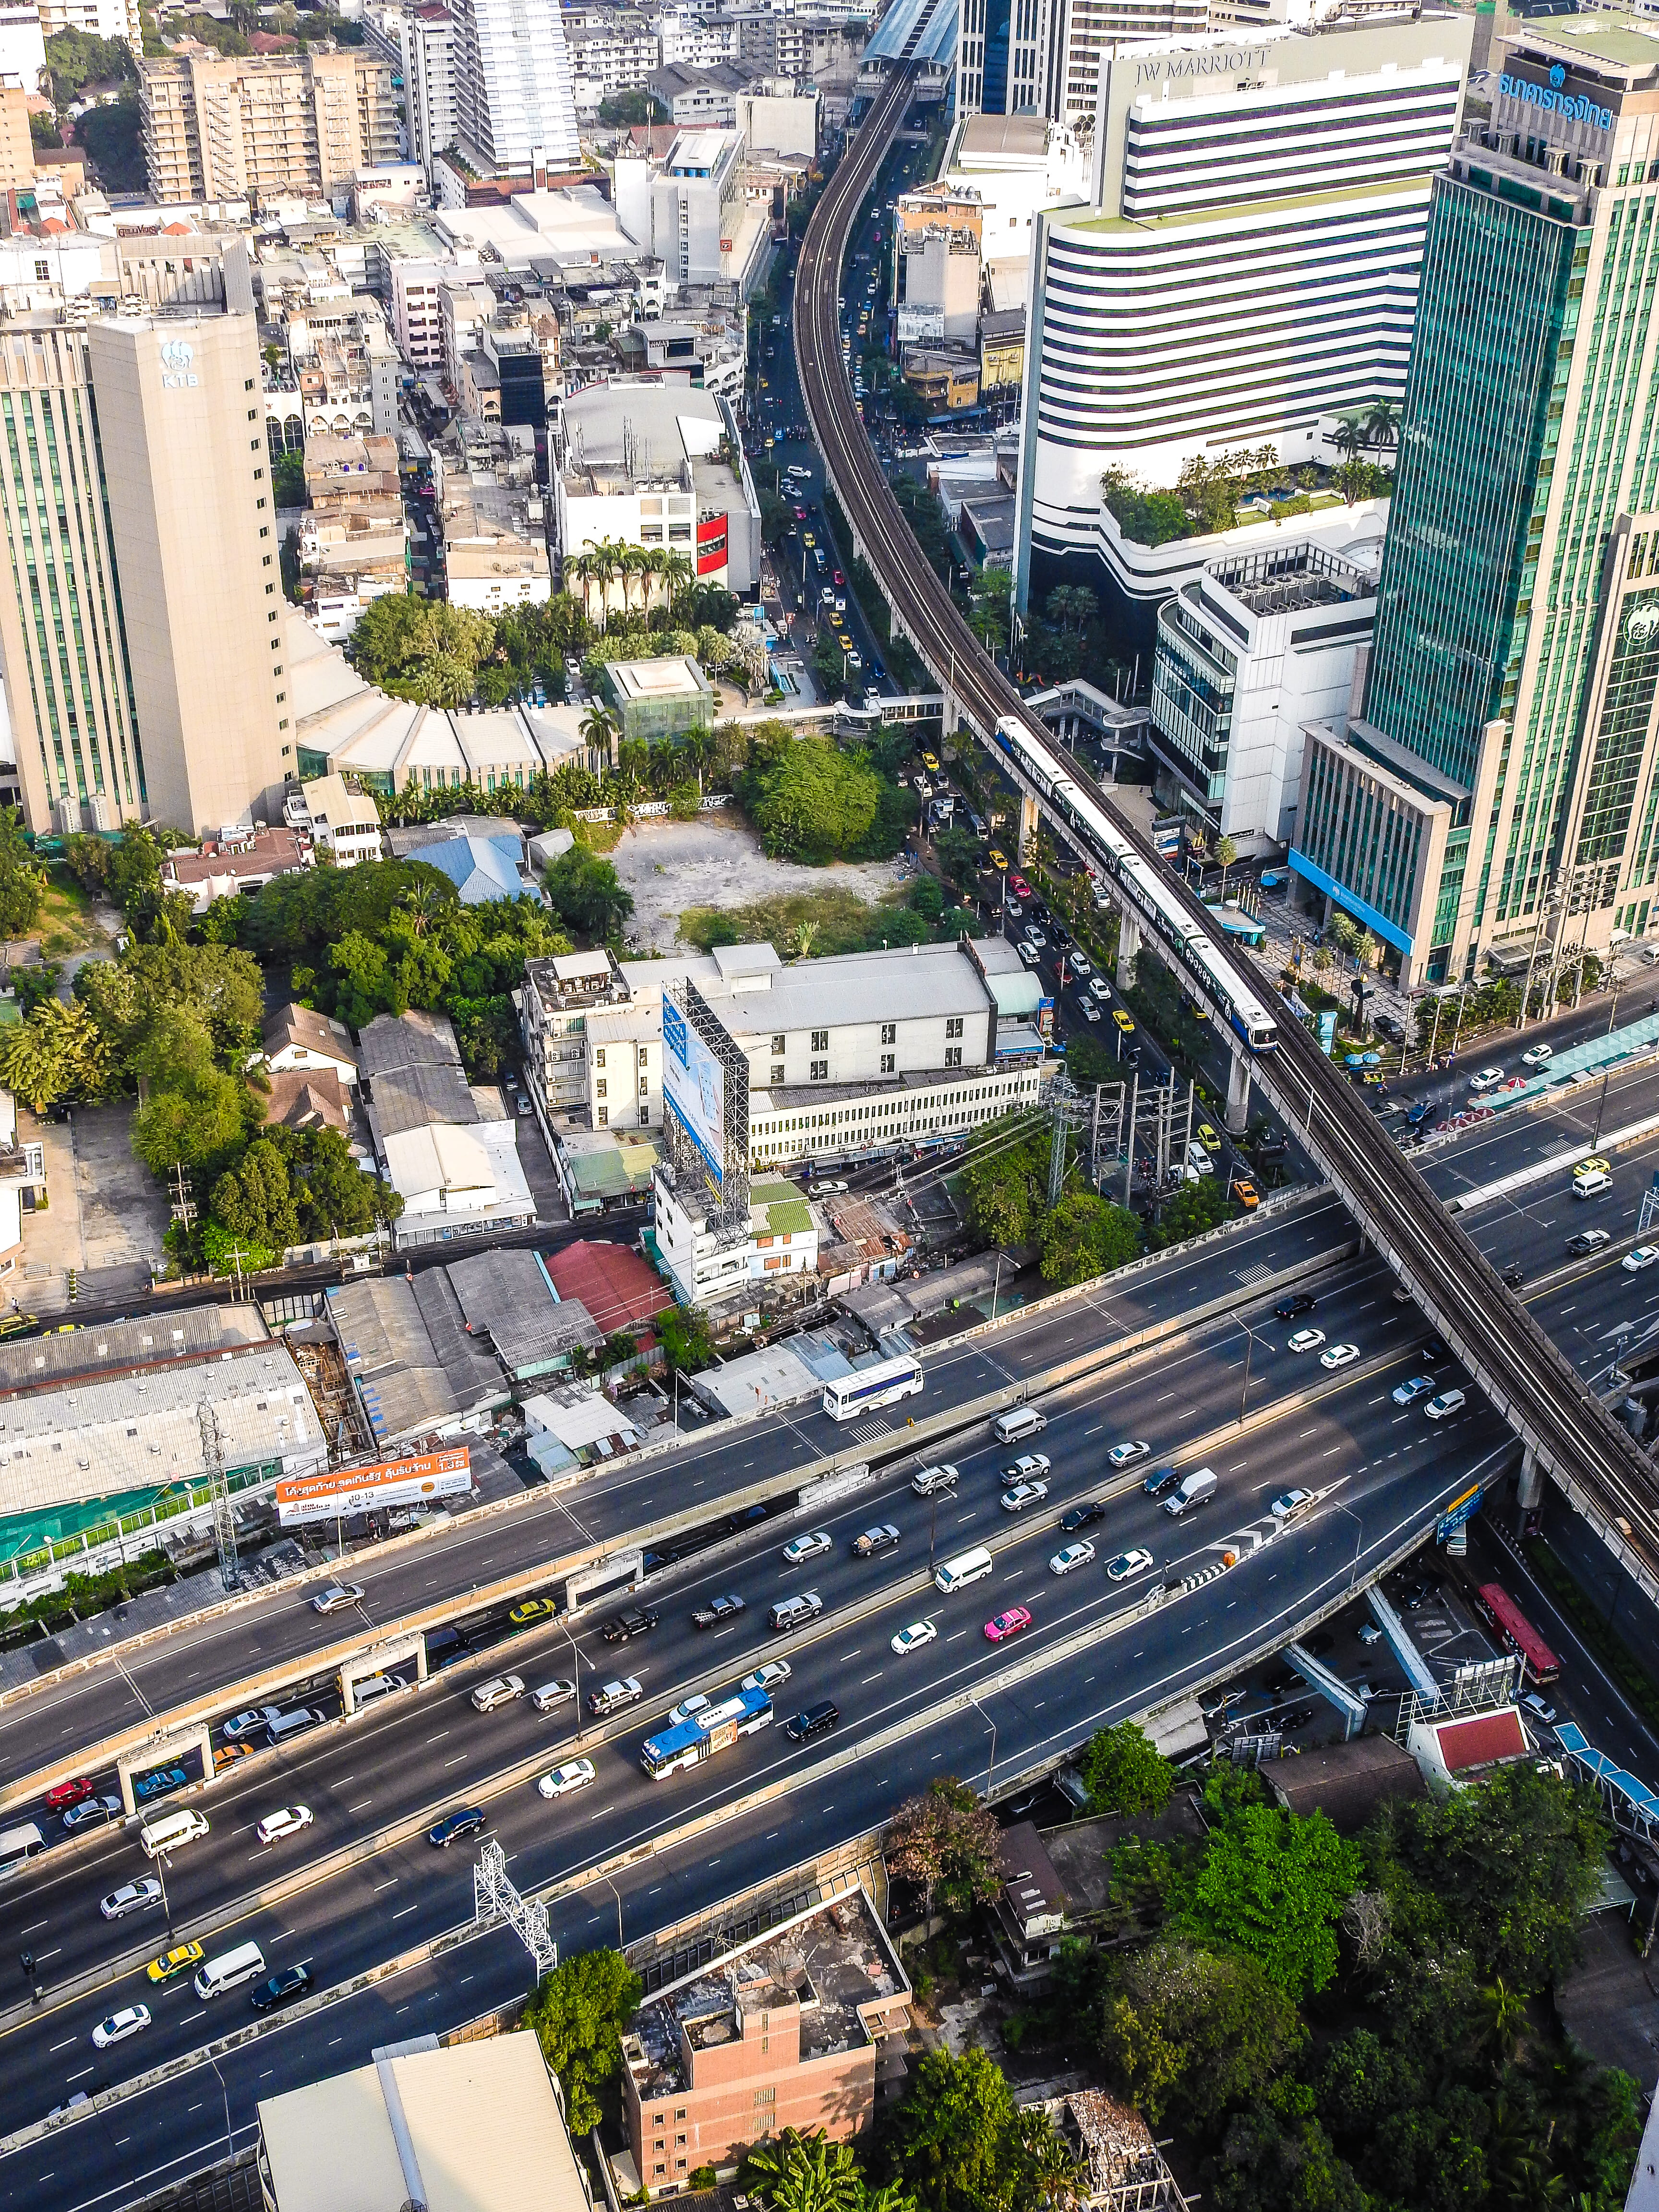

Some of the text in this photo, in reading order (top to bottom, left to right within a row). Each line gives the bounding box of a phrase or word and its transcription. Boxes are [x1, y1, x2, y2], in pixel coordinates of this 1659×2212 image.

[1134, 49, 1271, 88] JW MARRIOTT
[1499, 73, 1613, 131] ธนาคารกรุงไทย
[162, 373, 199, 388] KTB
[439, 1460, 455, 1471] 1.3
